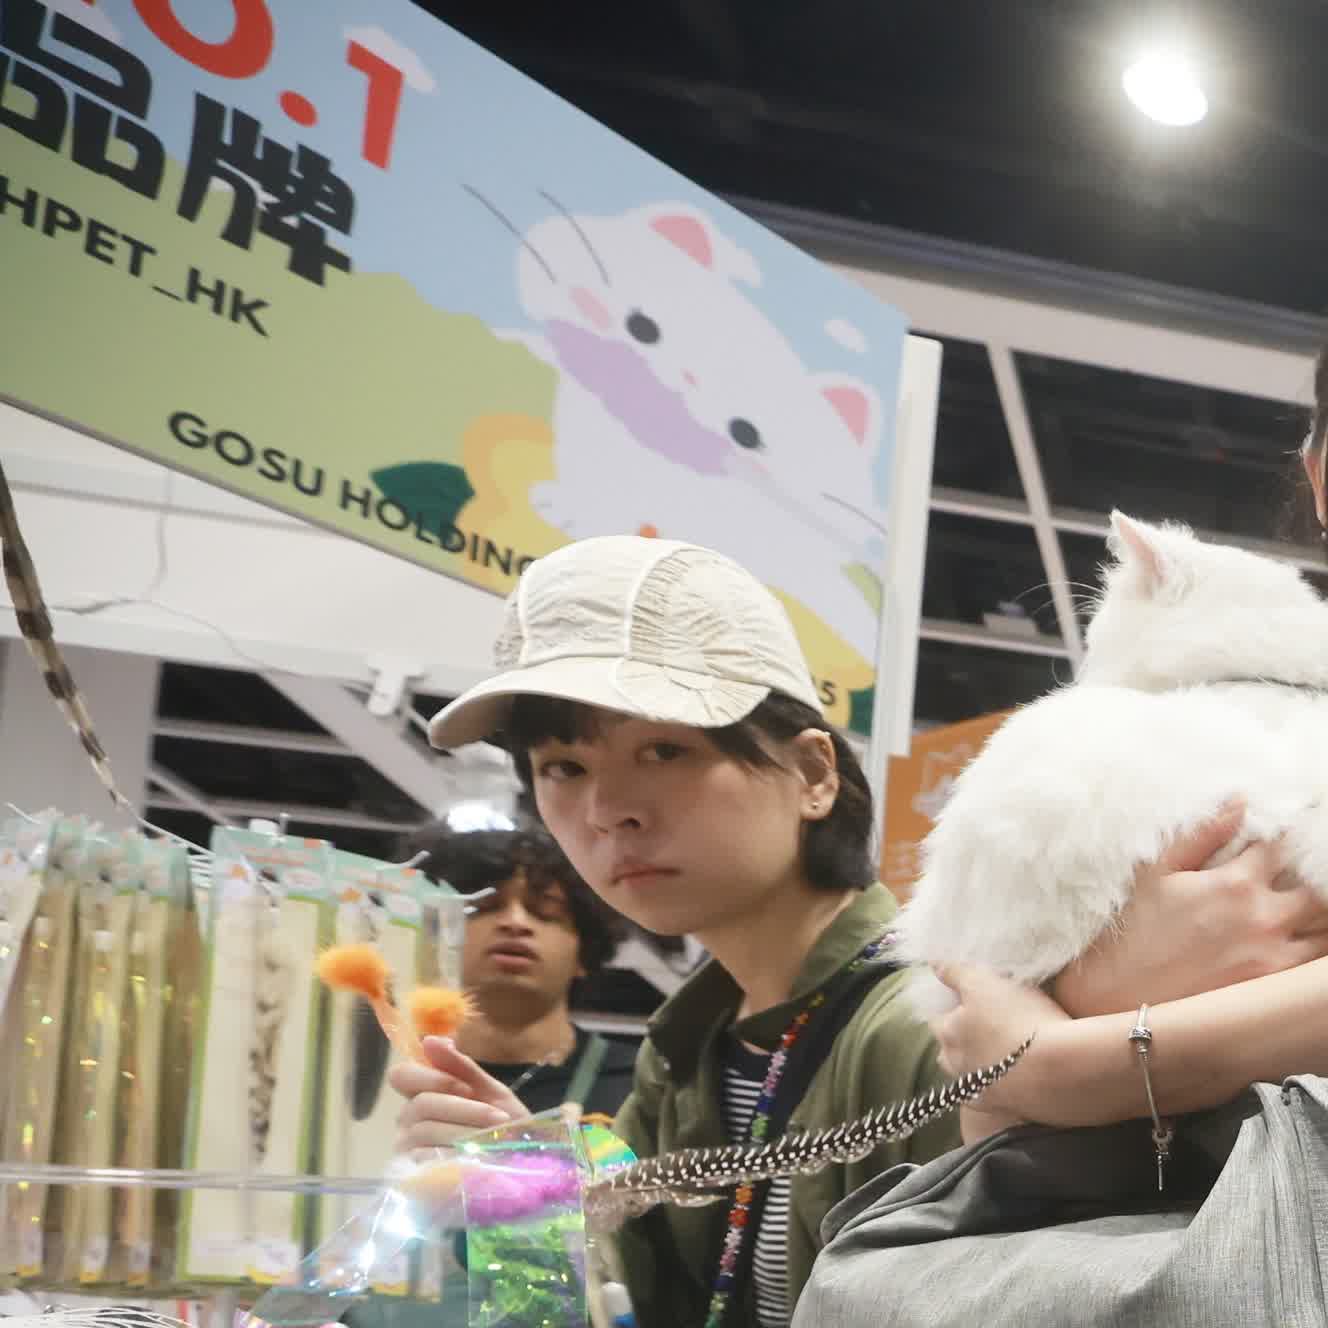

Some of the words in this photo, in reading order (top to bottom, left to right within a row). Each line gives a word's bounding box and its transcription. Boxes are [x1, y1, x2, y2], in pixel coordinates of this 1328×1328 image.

[0, 0, 355, 287] 品牌
[78, 0, 404, 171] O.1
[167, 410, 324, 498] GOSU
